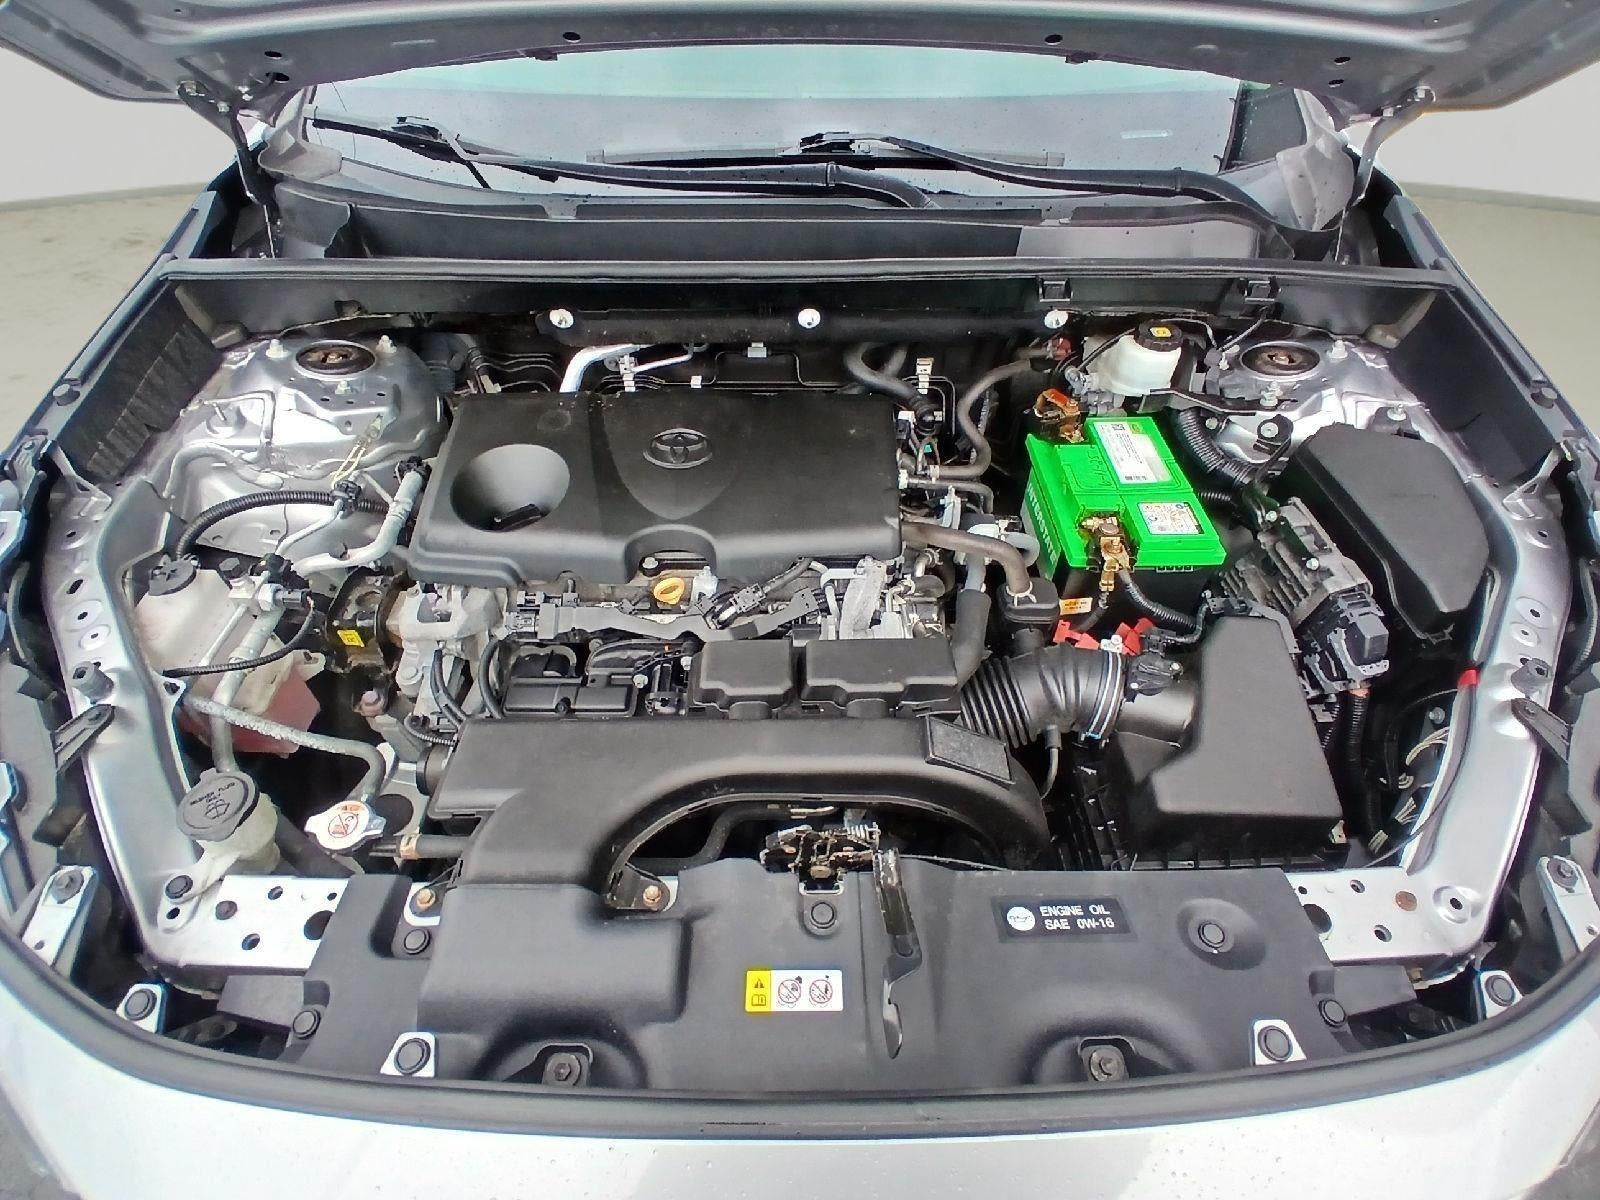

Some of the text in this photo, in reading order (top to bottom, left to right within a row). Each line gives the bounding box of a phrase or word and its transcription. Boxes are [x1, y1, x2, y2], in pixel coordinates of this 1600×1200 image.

[1028, 483, 1057, 565] INTERSTATE
[1039, 904, 1110, 917] ENGINE OIL
[1044, 918, 1071, 930] SAE
